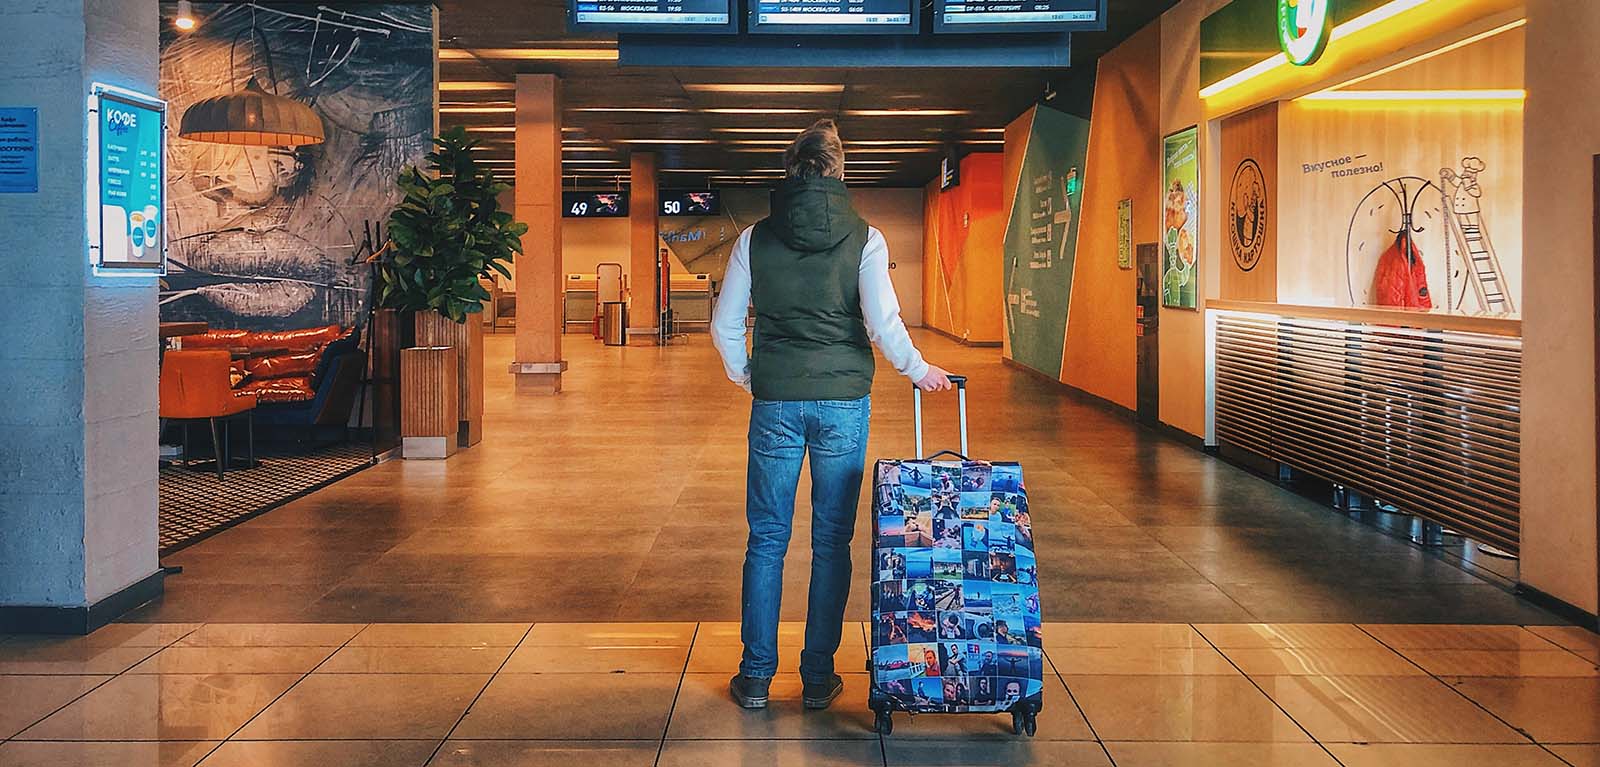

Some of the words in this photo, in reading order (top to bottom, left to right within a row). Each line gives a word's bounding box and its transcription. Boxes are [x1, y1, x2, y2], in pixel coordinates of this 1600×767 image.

[107, 108, 137, 128] КОФЕ
[1301, 156, 1352, 174] Вкусное
[1331, 162, 1384, 178] полезно!
[570, 202, 588, 215] 49
[664, 201, 681, 214] 50
